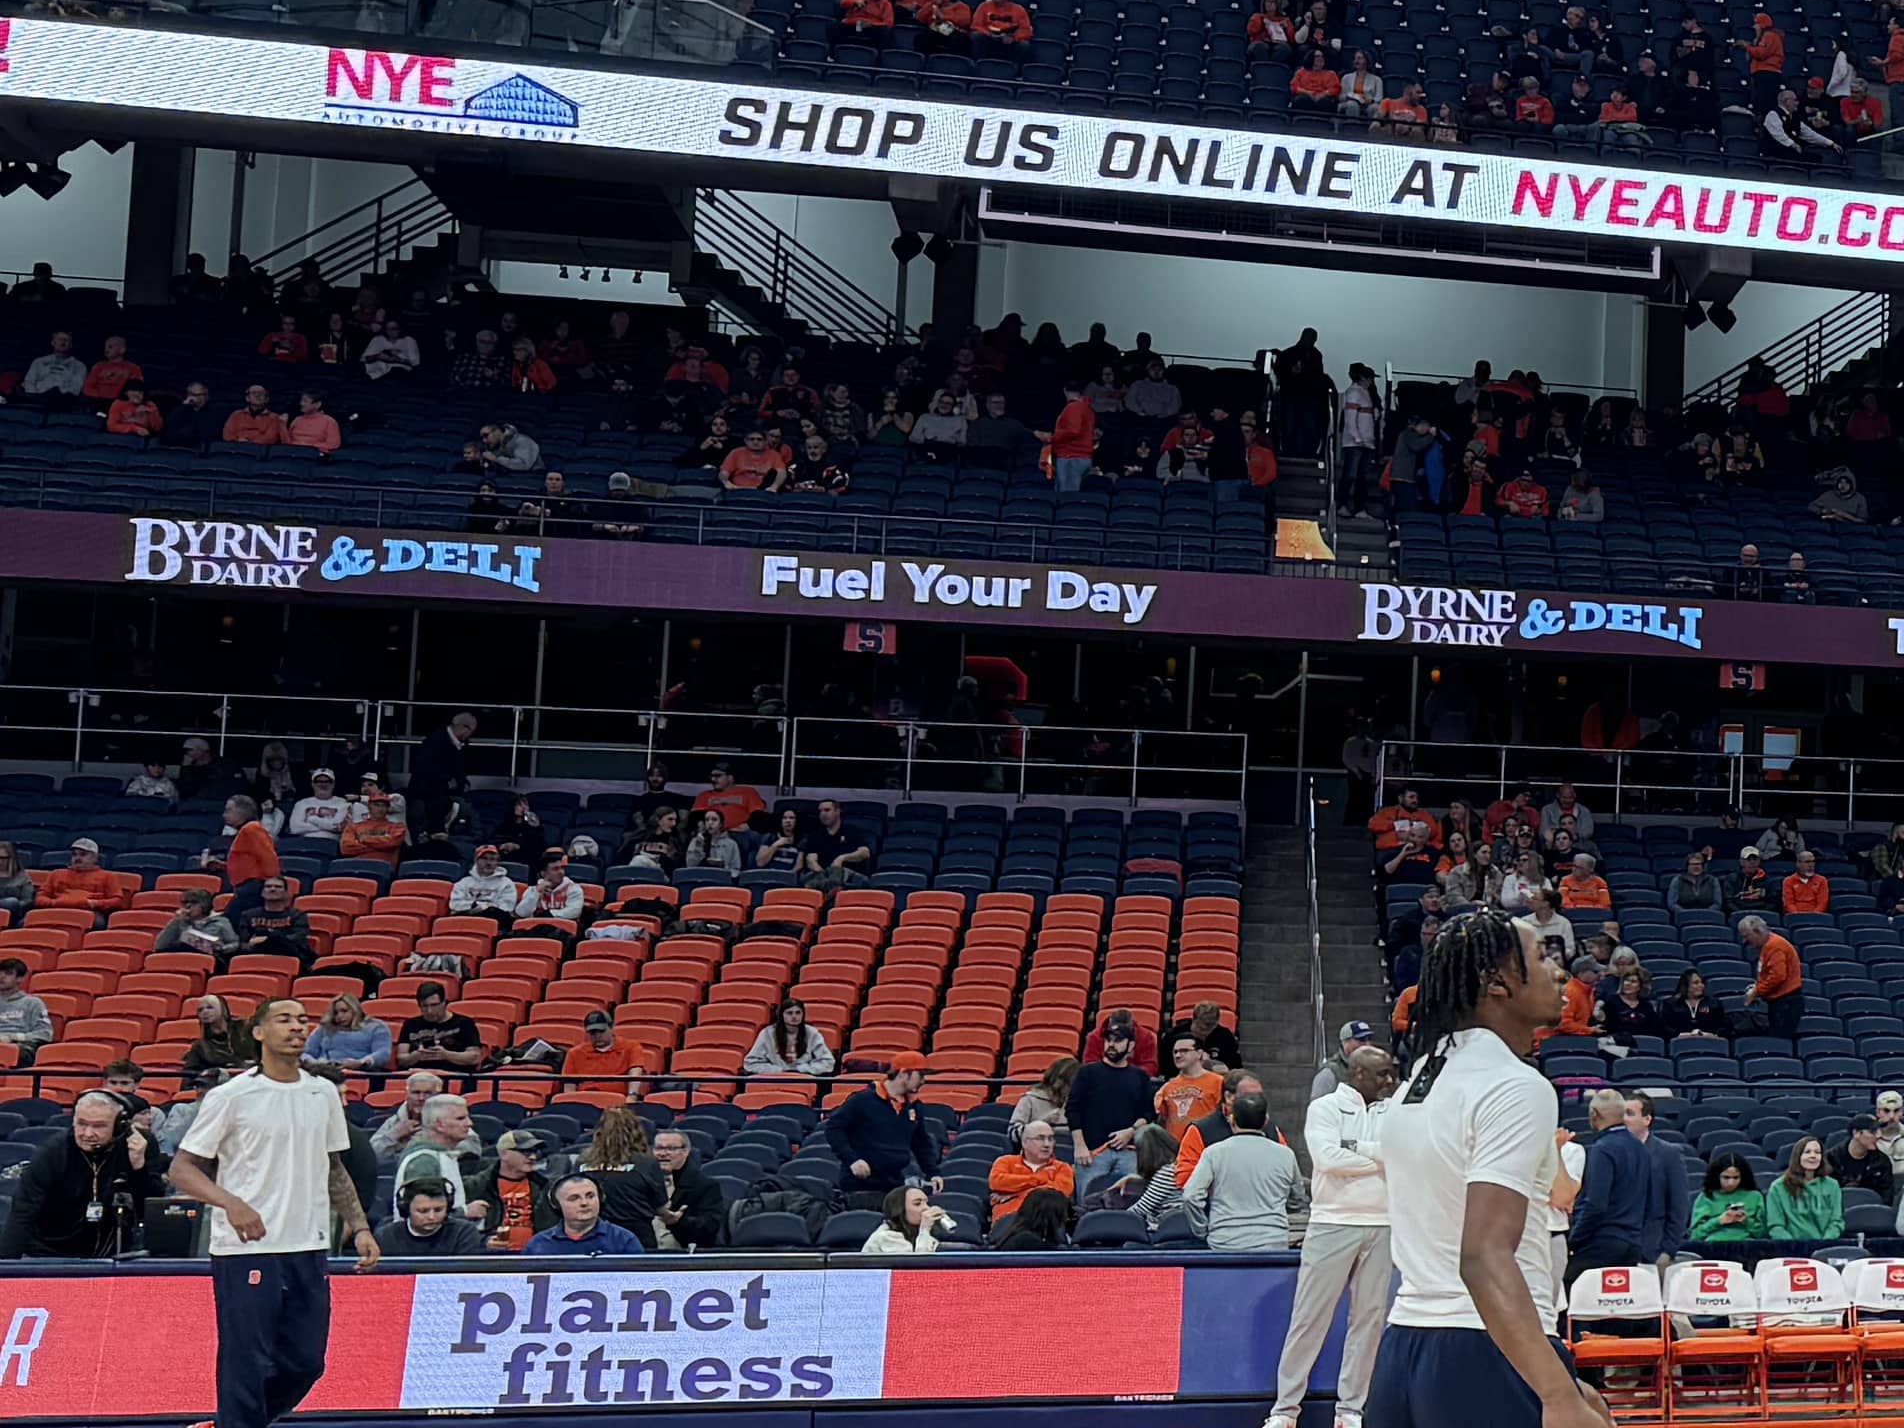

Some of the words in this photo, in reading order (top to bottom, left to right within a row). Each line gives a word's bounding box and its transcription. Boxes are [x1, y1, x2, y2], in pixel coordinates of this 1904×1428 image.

[324, 45, 457, 108] NYE
[717, 97, 926, 160] SHOP
[963, 117, 1061, 171] US
[1097, 132, 1362, 201] ONLINE
[1390, 160, 1482, 211] AT
[124, 516, 318, 582] BYRNE
[320, 535, 376, 581] &
[381, 538, 542, 594] DELI
[189, 558, 308, 590] DAIRY
[761, 555, 886, 603] Fuel
[900, 561, 1032, 610] Your
[1046, 570, 1158, 625] Day
[1357, 582, 1518, 643] BYRNE
[1519, 598, 1563, 641] &
[1568, 600, 1703, 650] DELI
[1411, 619, 1510, 648] DAIRY
[449, 1274, 772, 1354] planet
[1597, 1297, 1635, 1306] TOYOTA
[498, 1342, 836, 1405] fitness
